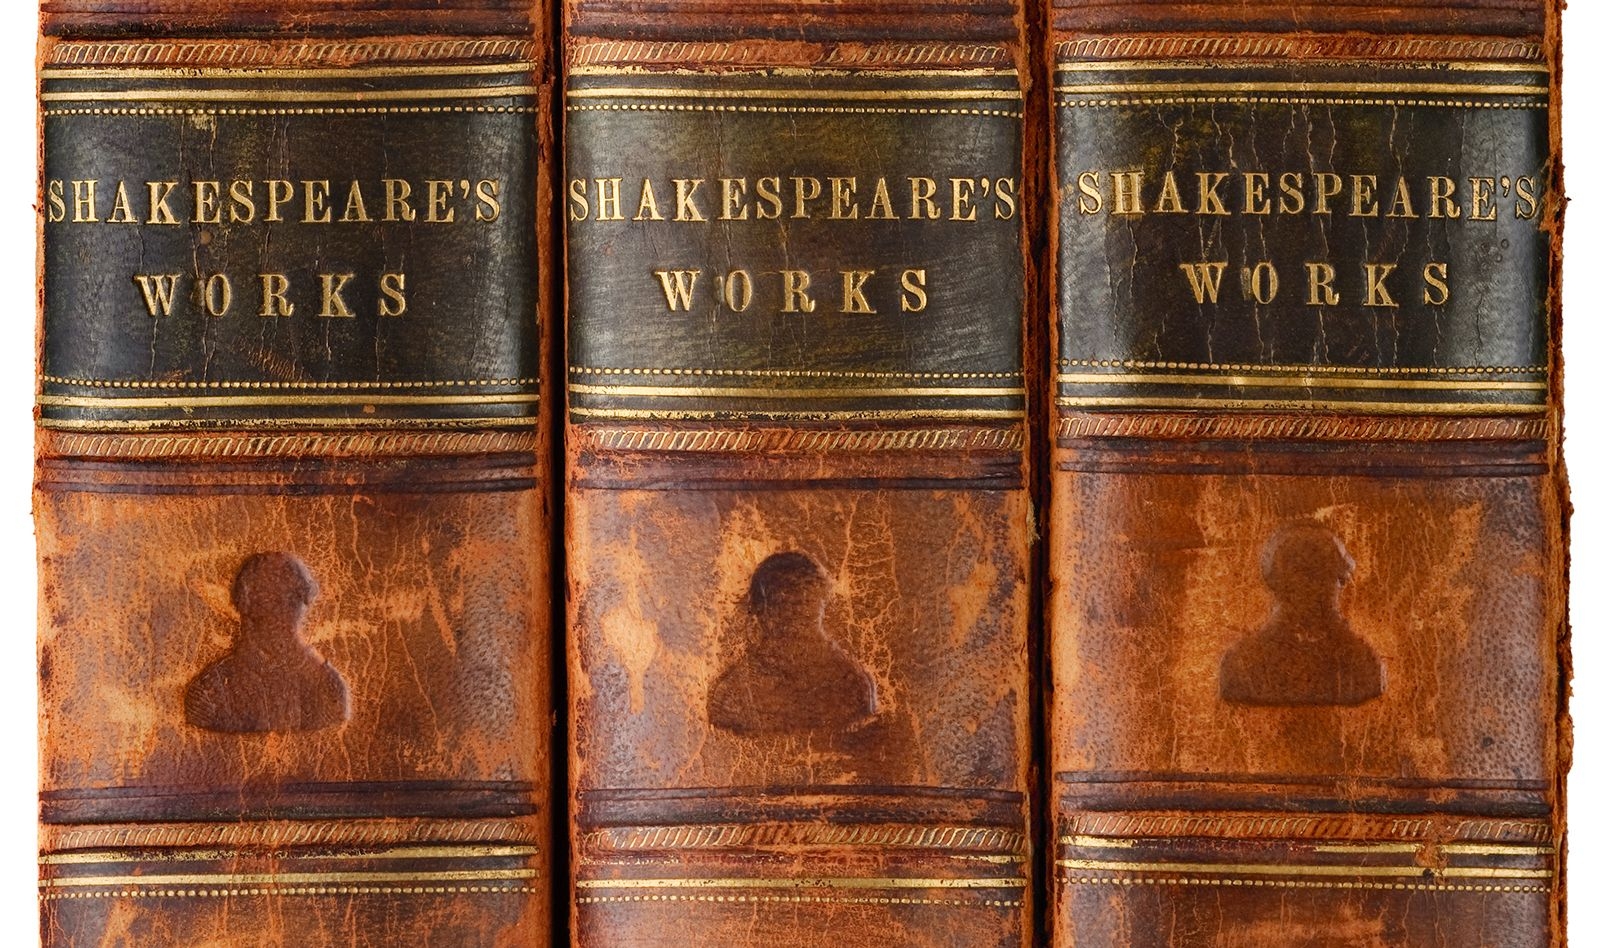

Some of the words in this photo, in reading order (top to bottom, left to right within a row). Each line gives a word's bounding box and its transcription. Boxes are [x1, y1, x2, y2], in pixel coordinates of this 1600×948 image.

[48, 178, 501, 225] SHAKESPEARE'S
[569, 176, 1017, 222] SHAKESPEARE'S
[1076, 170, 1539, 221] SHAKESPEARE'S
[134, 273, 408, 318] WORKS
[654, 269, 929, 314] WORKS
[1179, 260, 1450, 308] WORKS
